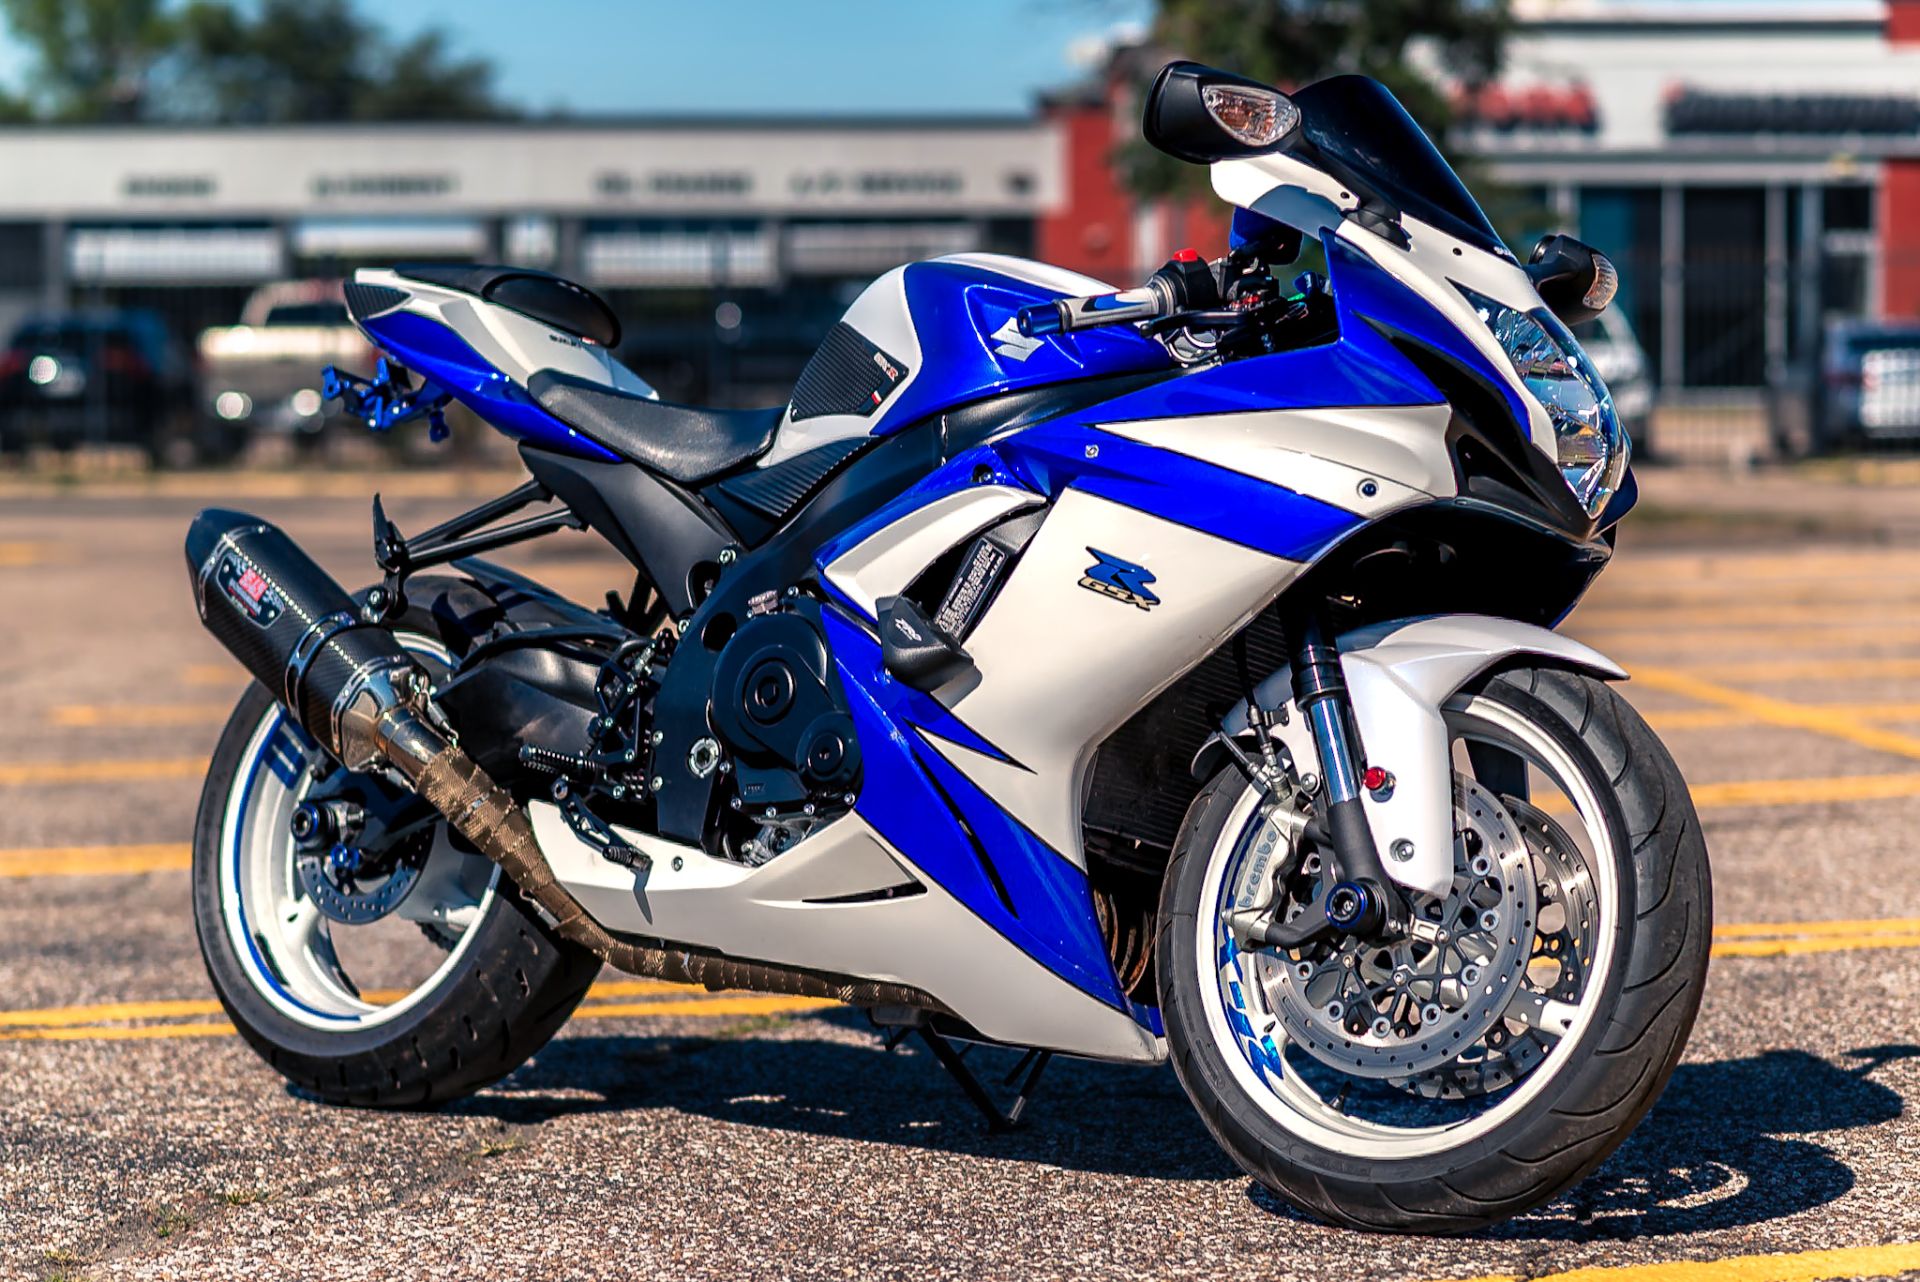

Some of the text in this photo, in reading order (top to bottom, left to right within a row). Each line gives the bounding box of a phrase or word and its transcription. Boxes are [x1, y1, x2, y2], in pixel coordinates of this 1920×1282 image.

[1078, 577, 1158, 612] GSX
[1085, 546, 1160, 604] R
[1237, 830, 1277, 908] brembo
